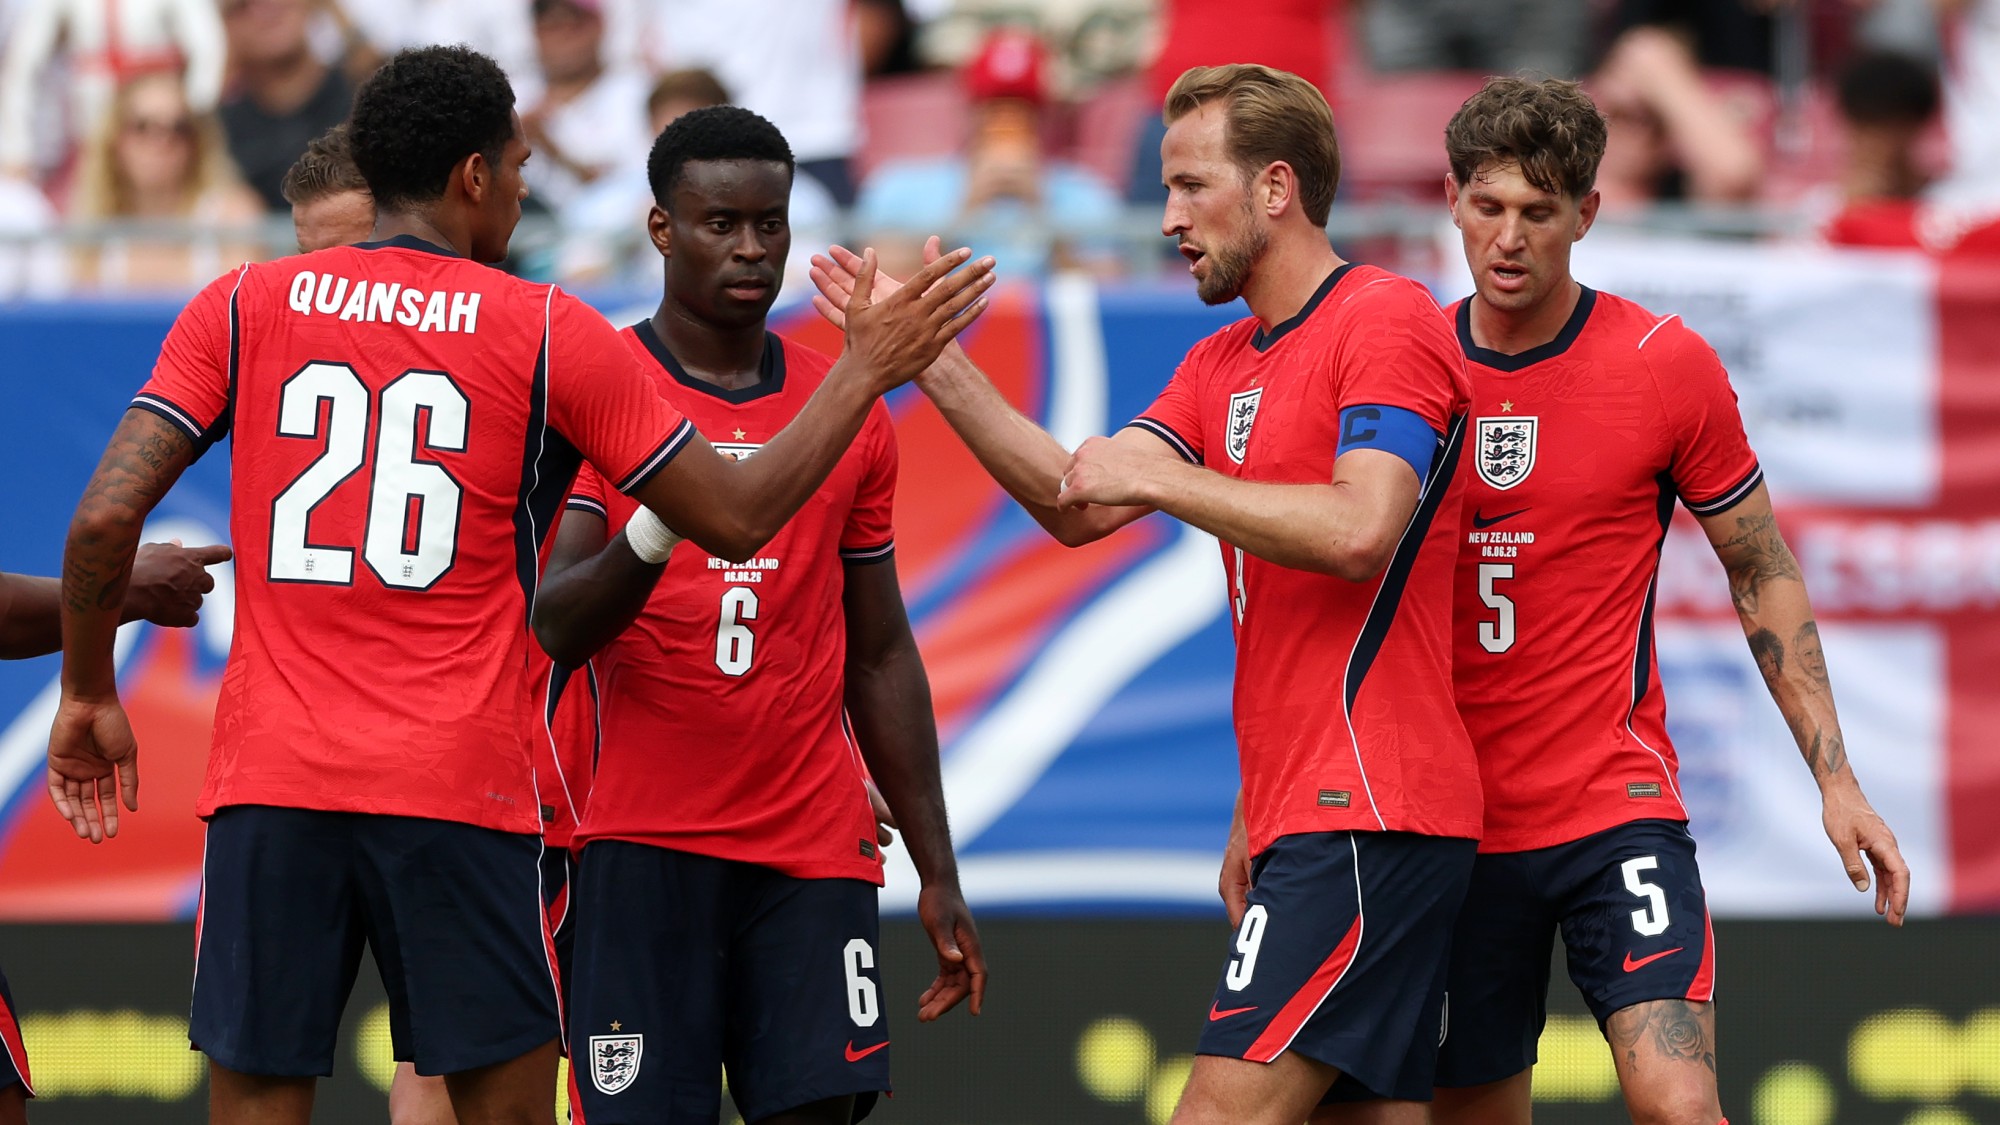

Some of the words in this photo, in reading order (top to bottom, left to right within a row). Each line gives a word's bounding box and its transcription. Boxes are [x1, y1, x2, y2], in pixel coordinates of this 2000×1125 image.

[288, 270, 482, 334] QUANSAH
[1340, 408, 1382, 447] C
[267, 360, 472, 592] 26
[707, 558, 731, 569] NEW
[1469, 532, 1489, 543] NEW
[1490, 532, 1535, 544] ZEALAND
[1481, 545, 1518, 558] 06.06.26
[724, 571, 762, 583] 06.06.26
[1478, 563, 1516, 653] 5
[715, 586, 759, 677] 6
[1620, 855, 1671, 937] 5
[843, 938, 880, 1027] 6
[1225, 904, 1269, 992] 9
